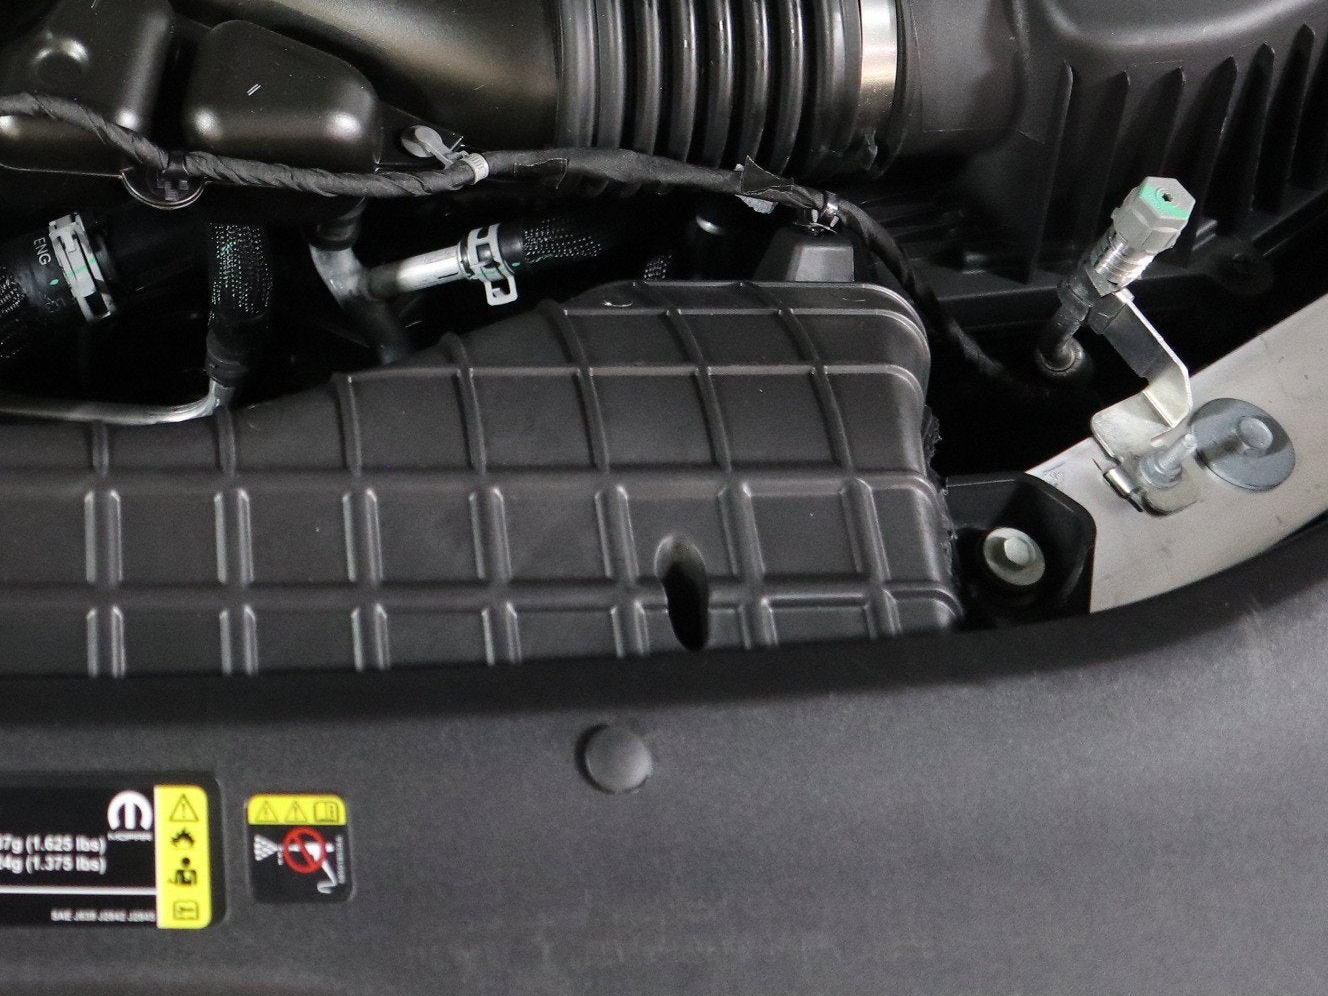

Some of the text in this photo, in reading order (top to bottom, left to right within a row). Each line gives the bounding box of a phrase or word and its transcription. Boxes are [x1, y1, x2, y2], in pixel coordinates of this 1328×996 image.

[33, 237, 51, 265] ENG
[26, 834, 71, 853] (1.625
[76, 834, 106, 853] lbs)
[26, 854, 72, 874] (1.375
[76, 854, 106, 874] lbs)
